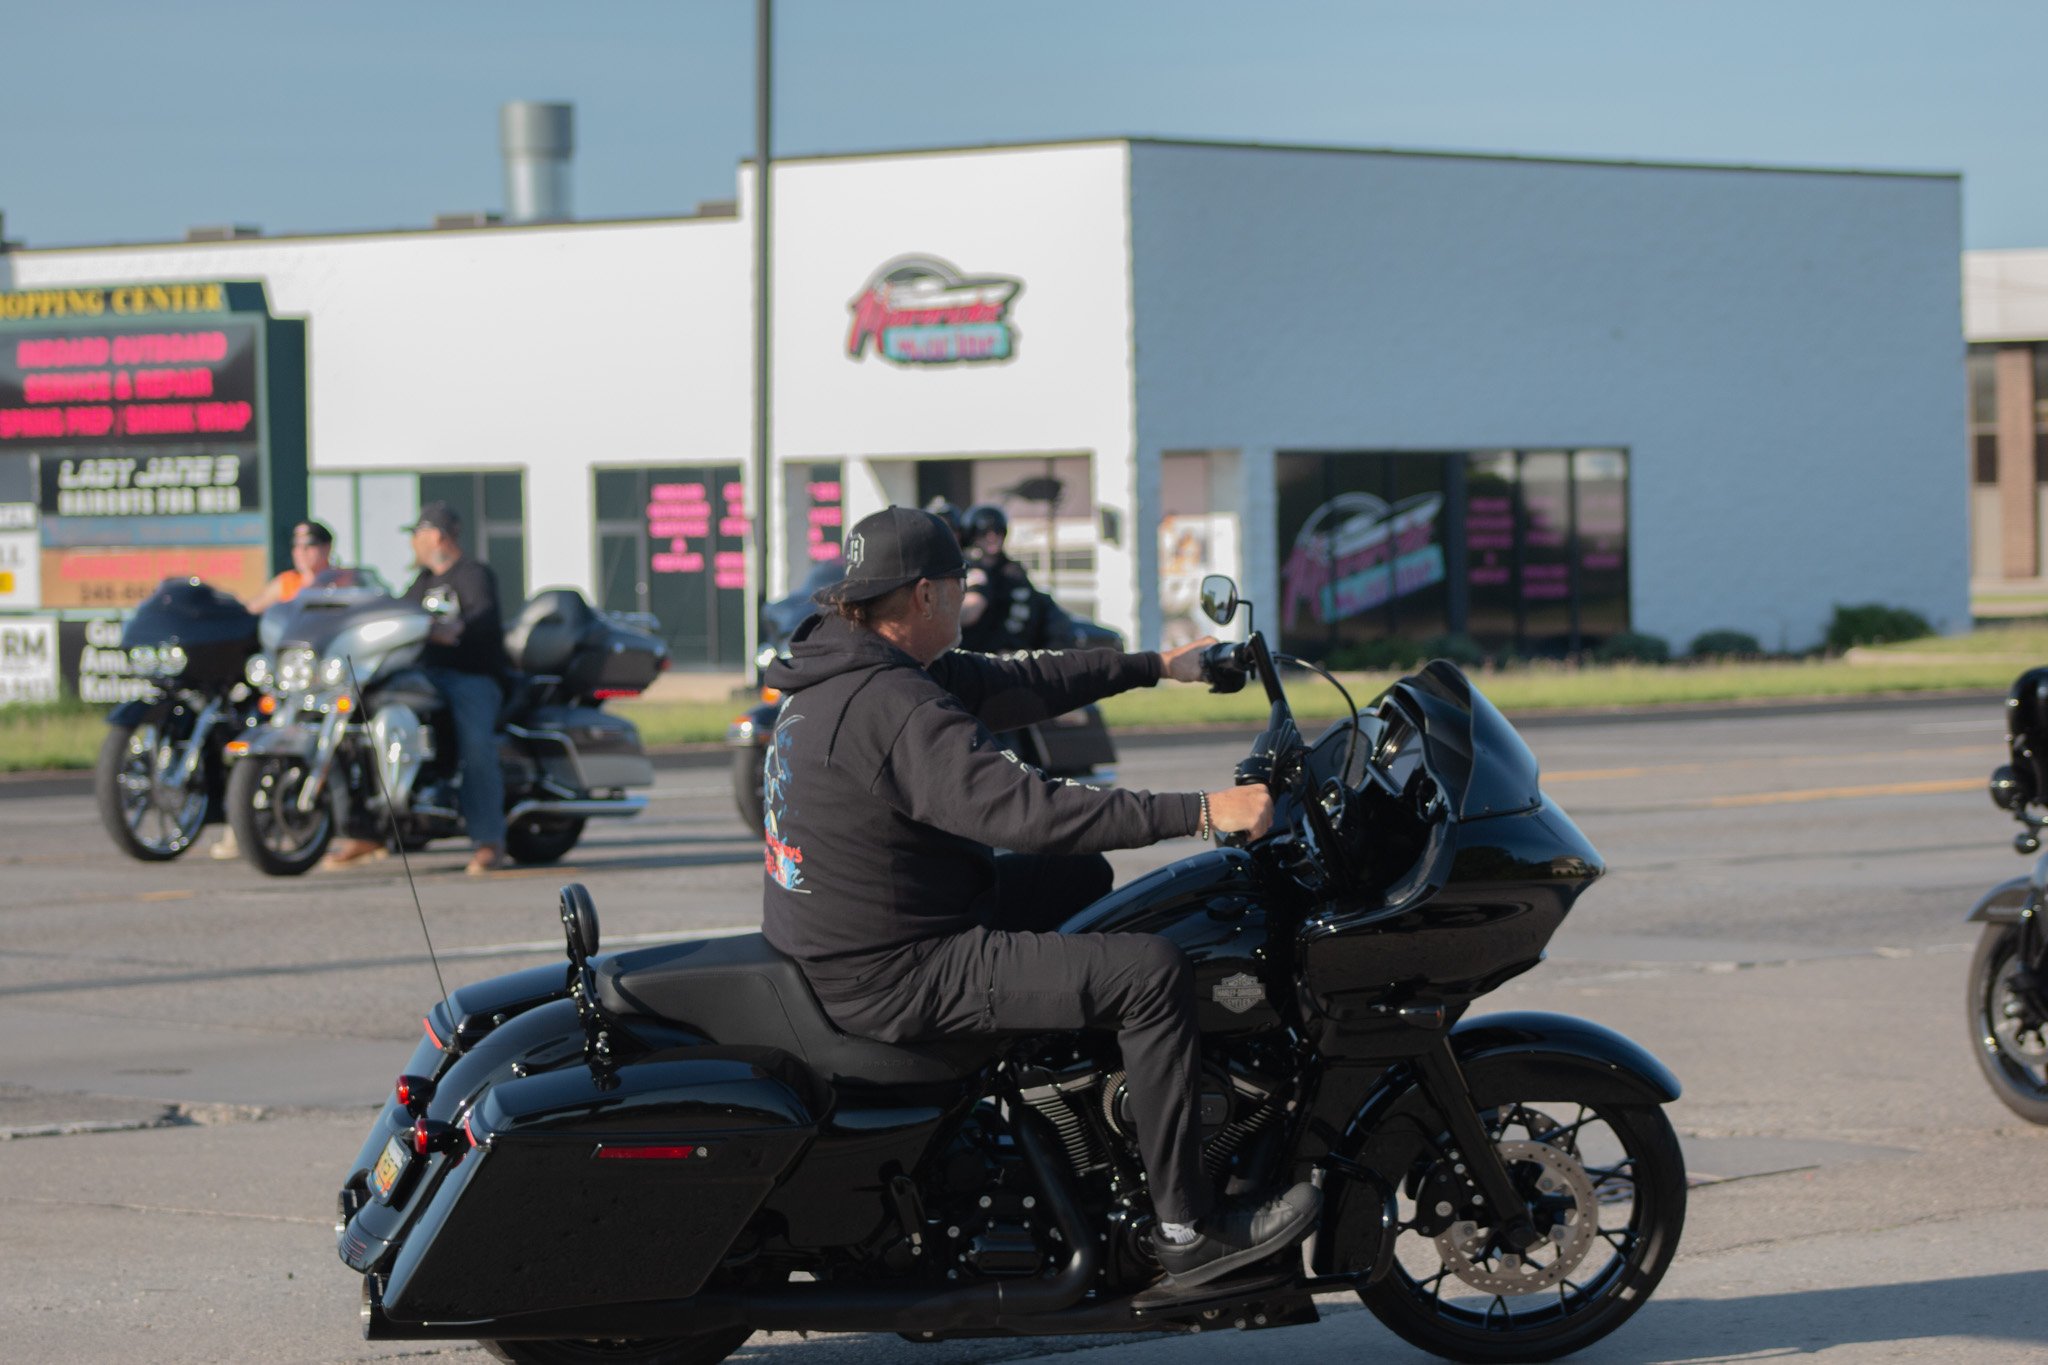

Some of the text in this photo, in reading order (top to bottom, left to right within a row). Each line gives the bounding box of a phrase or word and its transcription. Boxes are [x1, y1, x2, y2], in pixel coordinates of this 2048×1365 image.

[111, 283, 223, 315] CENTER
[58, 459, 136, 489] LADY
[0, 628, 47, 657] RM
[86, 618, 122, 648] Gu
